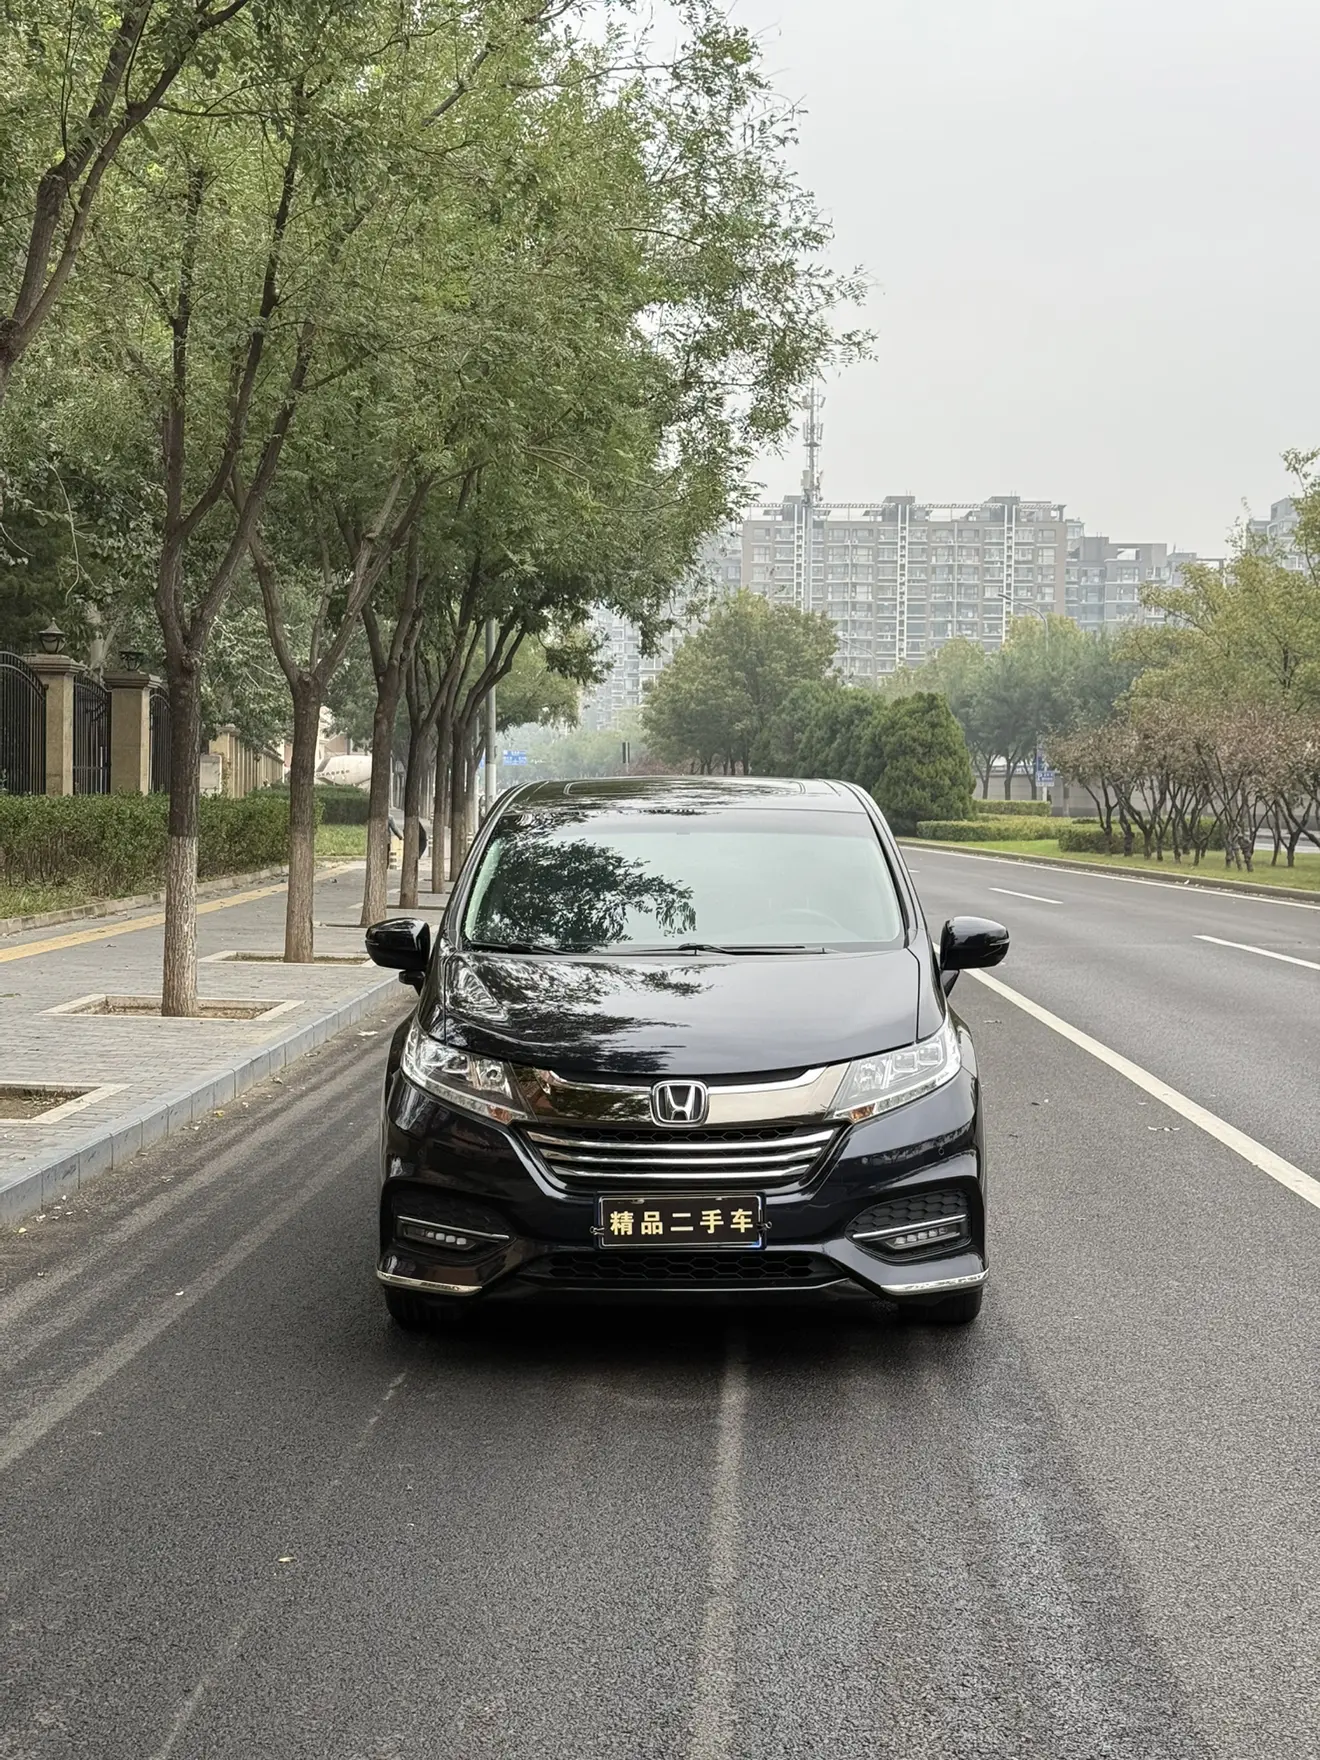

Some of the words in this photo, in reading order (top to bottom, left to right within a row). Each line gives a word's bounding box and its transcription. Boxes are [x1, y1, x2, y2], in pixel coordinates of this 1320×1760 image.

[610, 1208, 753, 1235] 精品二手车
